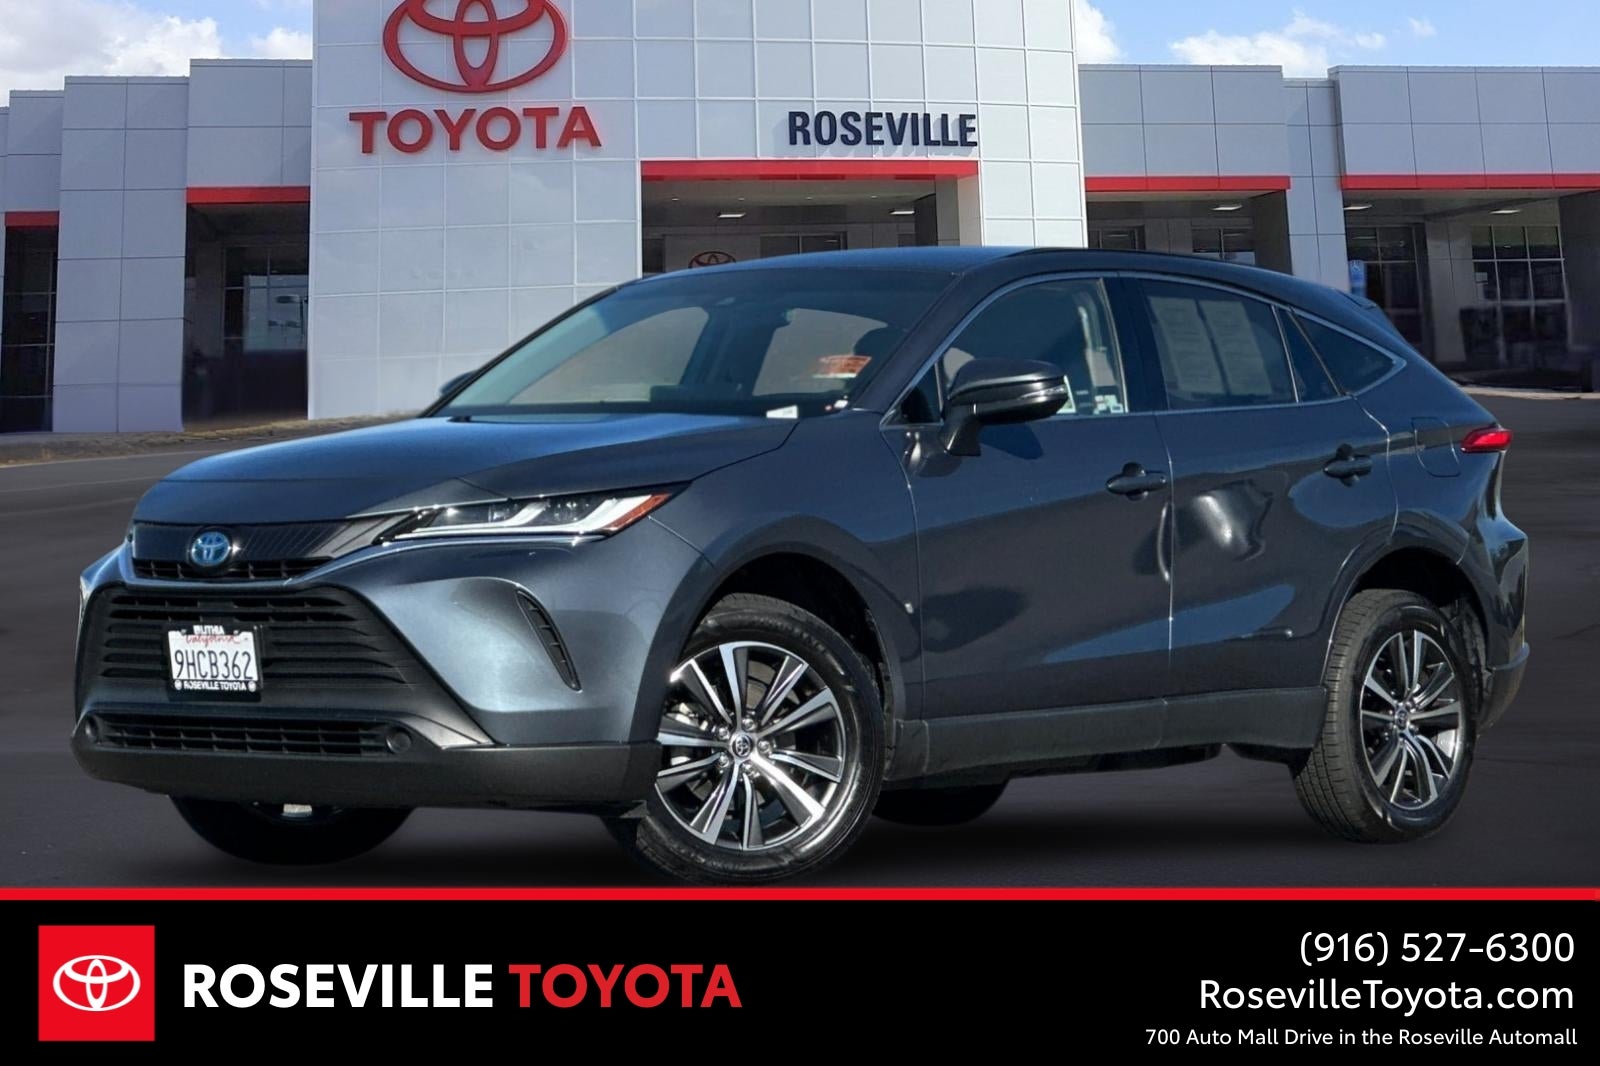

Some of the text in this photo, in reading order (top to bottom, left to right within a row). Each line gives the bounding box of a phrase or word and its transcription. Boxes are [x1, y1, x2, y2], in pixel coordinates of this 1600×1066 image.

[349, 106, 602, 154] TOYOTA
[788, 110, 978, 147] ROSEVILLE
[174, 649, 253, 680] 9HCB362
[183, 680, 247, 691] ROSEVILLE TOYOTA
